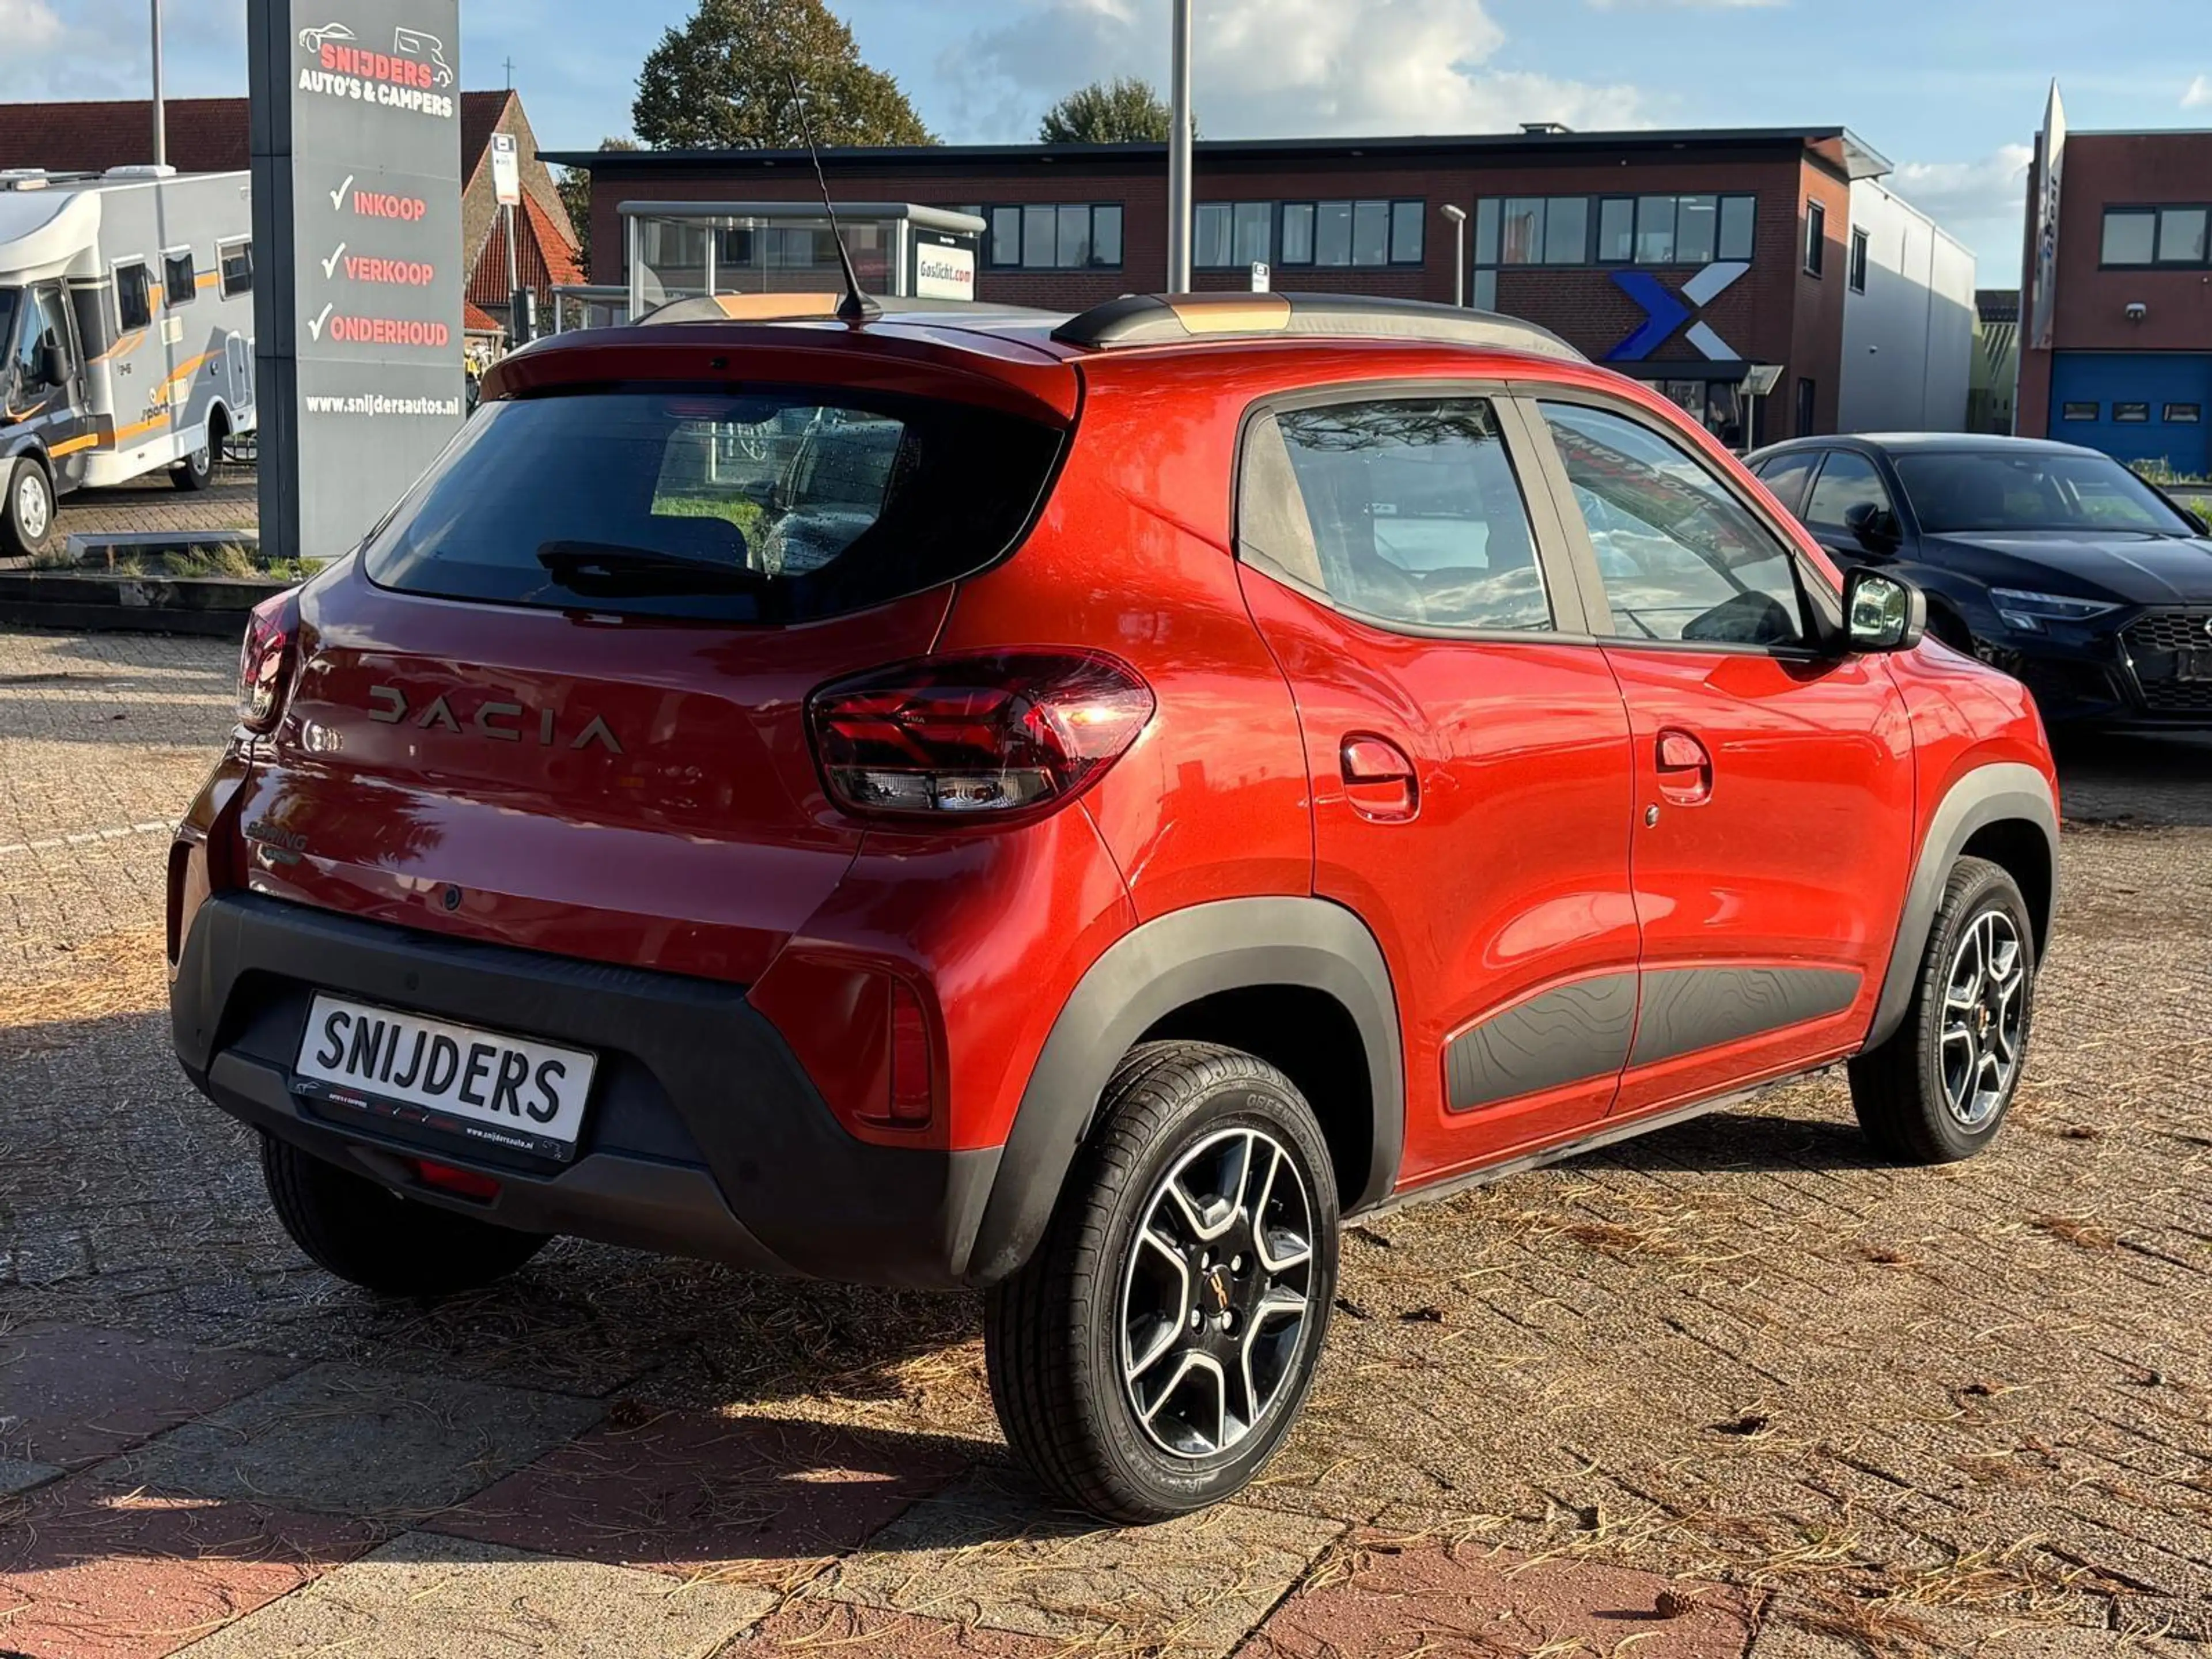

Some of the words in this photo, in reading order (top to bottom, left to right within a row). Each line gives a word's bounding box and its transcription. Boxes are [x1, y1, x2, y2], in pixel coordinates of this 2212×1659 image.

[320, 43, 433, 88] SNIJDERS
[299, 69, 361, 99] AUTO'S
[363, 84, 376, 102] &
[378, 86, 453, 118] CAMPERS
[354, 191, 426, 221] INKOOP
[345, 256, 434, 286] VERKOOP
[920, 260, 971, 283] Gaslicht.com
[330, 316, 448, 346] ONDERHOUD
[306, 395, 459, 416] www.snijdersautos.nl
[368, 685, 623, 753] DACIA
[316, 1011, 566, 1123] SNIJDERS
